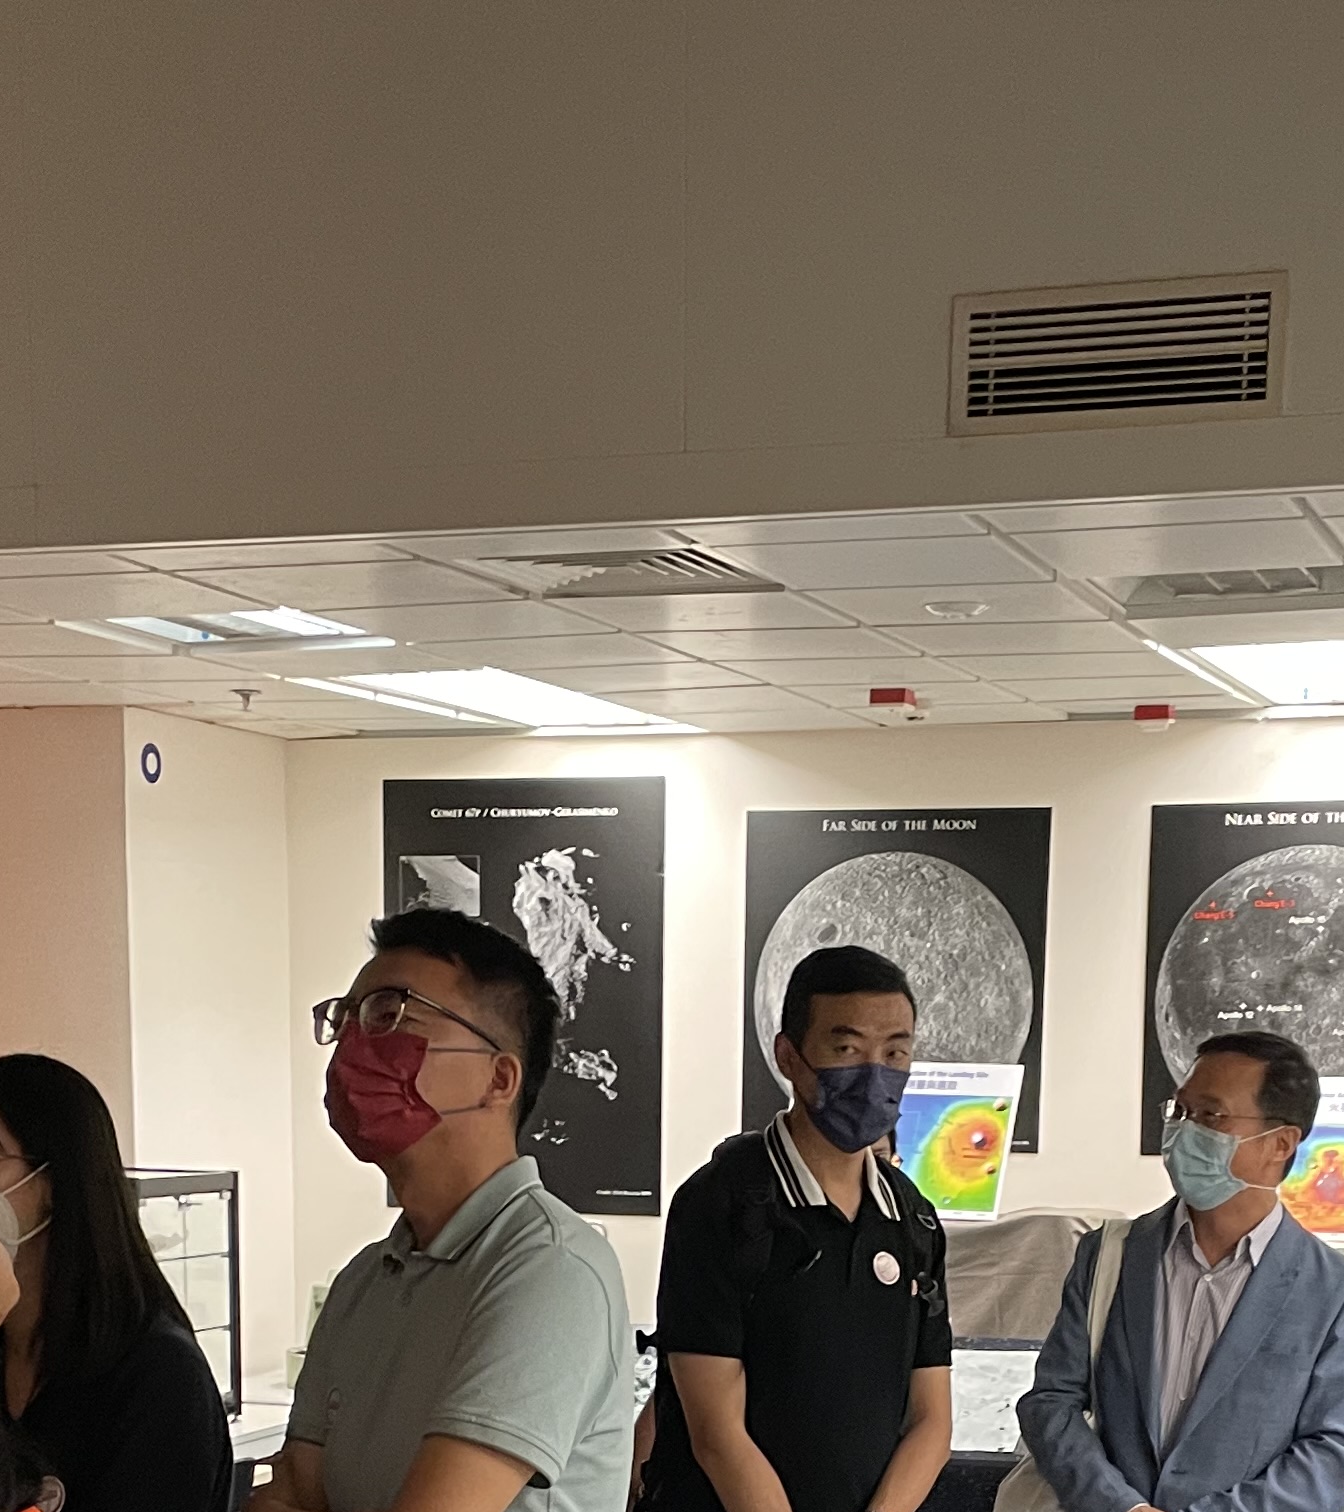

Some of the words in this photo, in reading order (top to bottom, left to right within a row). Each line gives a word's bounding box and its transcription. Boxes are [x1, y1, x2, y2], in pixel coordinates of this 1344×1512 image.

[1224, 812, 1263, 826] NEAR
[1267, 811, 1297, 825] SIDE
[1301, 812, 1321, 824] OF
[822, 818, 847, 832] FAR
[850, 818, 877, 832] SIDE
[881, 820, 899, 831] OF
[904, 820, 927, 831] THE
[932, 818, 977, 831] MOON
[1288, 915, 1315, 925] Apollo
[1266, 1004, 1292, 1013] Apollo
[1217, 1010, 1244, 1021] Apollo
